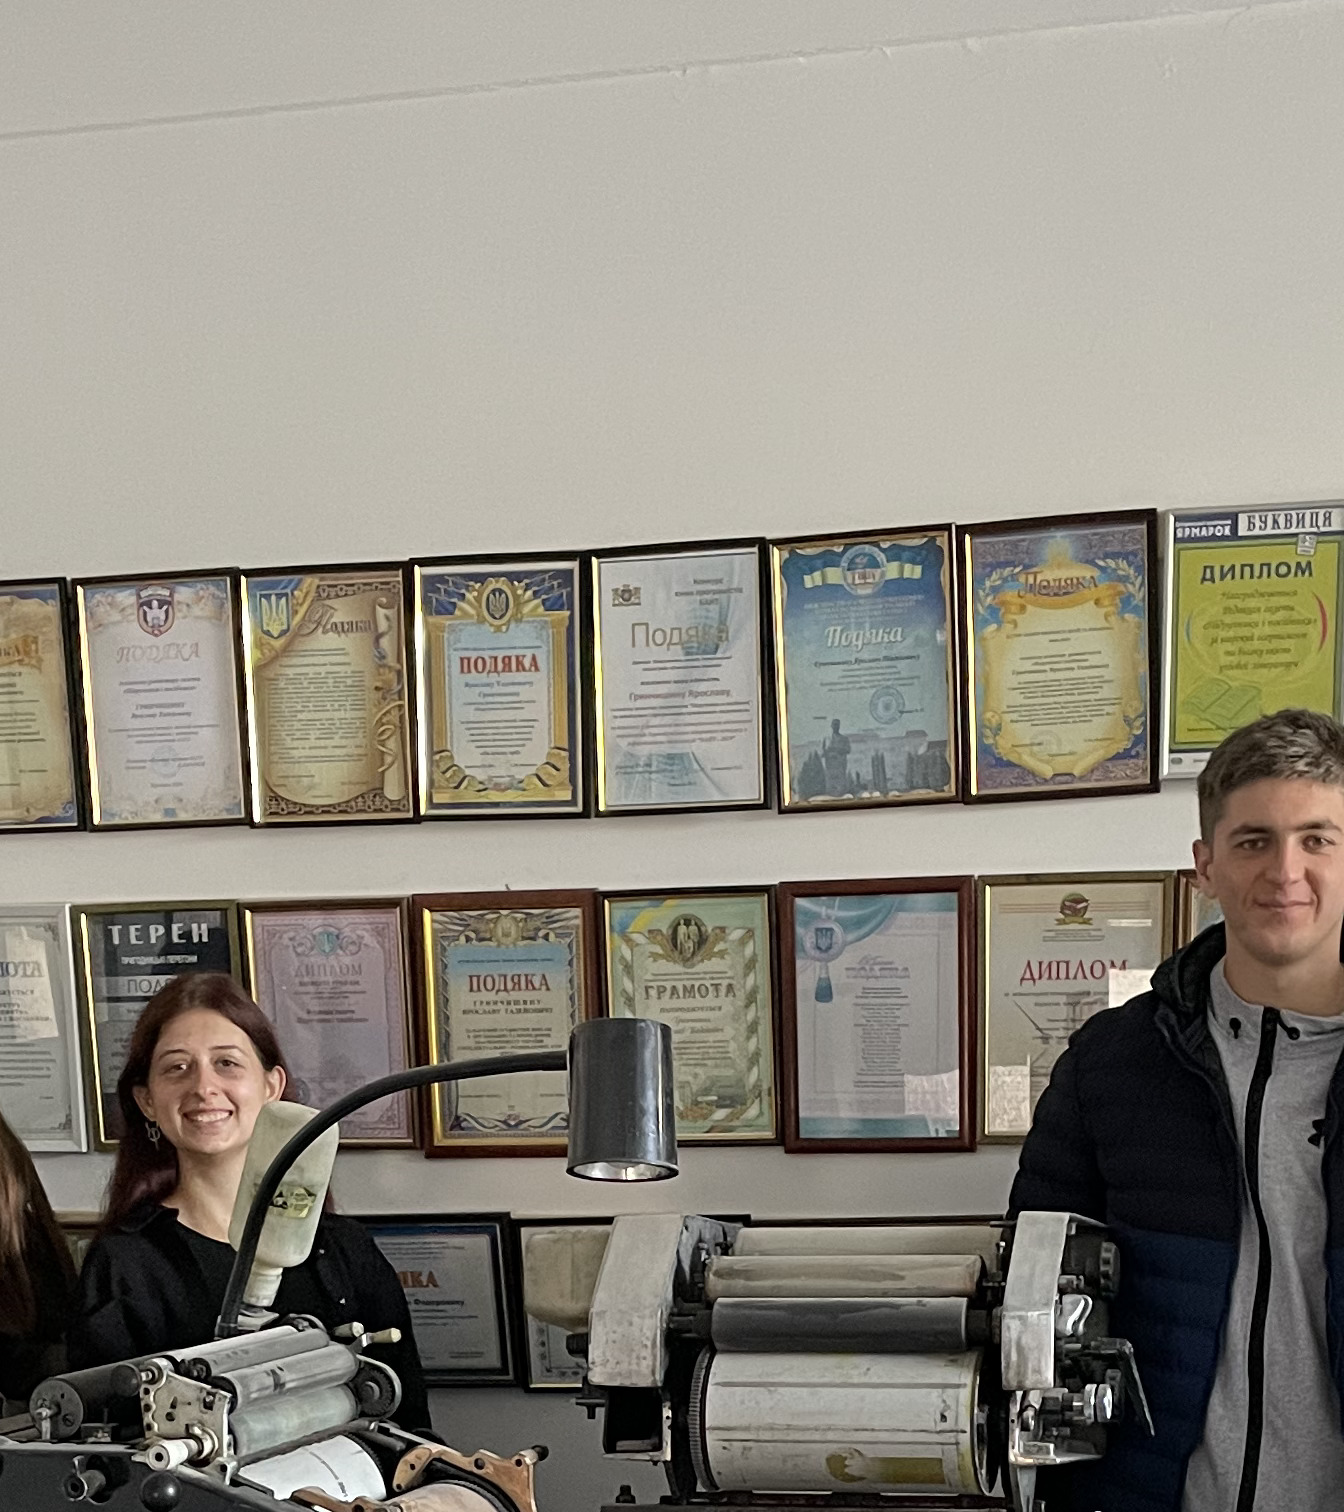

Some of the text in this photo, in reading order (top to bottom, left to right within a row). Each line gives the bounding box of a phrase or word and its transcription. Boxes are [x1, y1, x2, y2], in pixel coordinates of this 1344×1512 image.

[1175, 510, 1333, 539] ЯРМАРОК БУКВИЦЯ
[1200, 560, 1313, 585] ДИПЛОМ
[632, 622, 730, 651] Подяка
[824, 625, 905, 652] Подяка
[459, 653, 541, 678] ПОДЯКА
[108, 922, 209, 945] ТЕРЕН
[468, 973, 551, 996] ПОДЯКА
[644, 983, 737, 1000] ГРАМОТА
